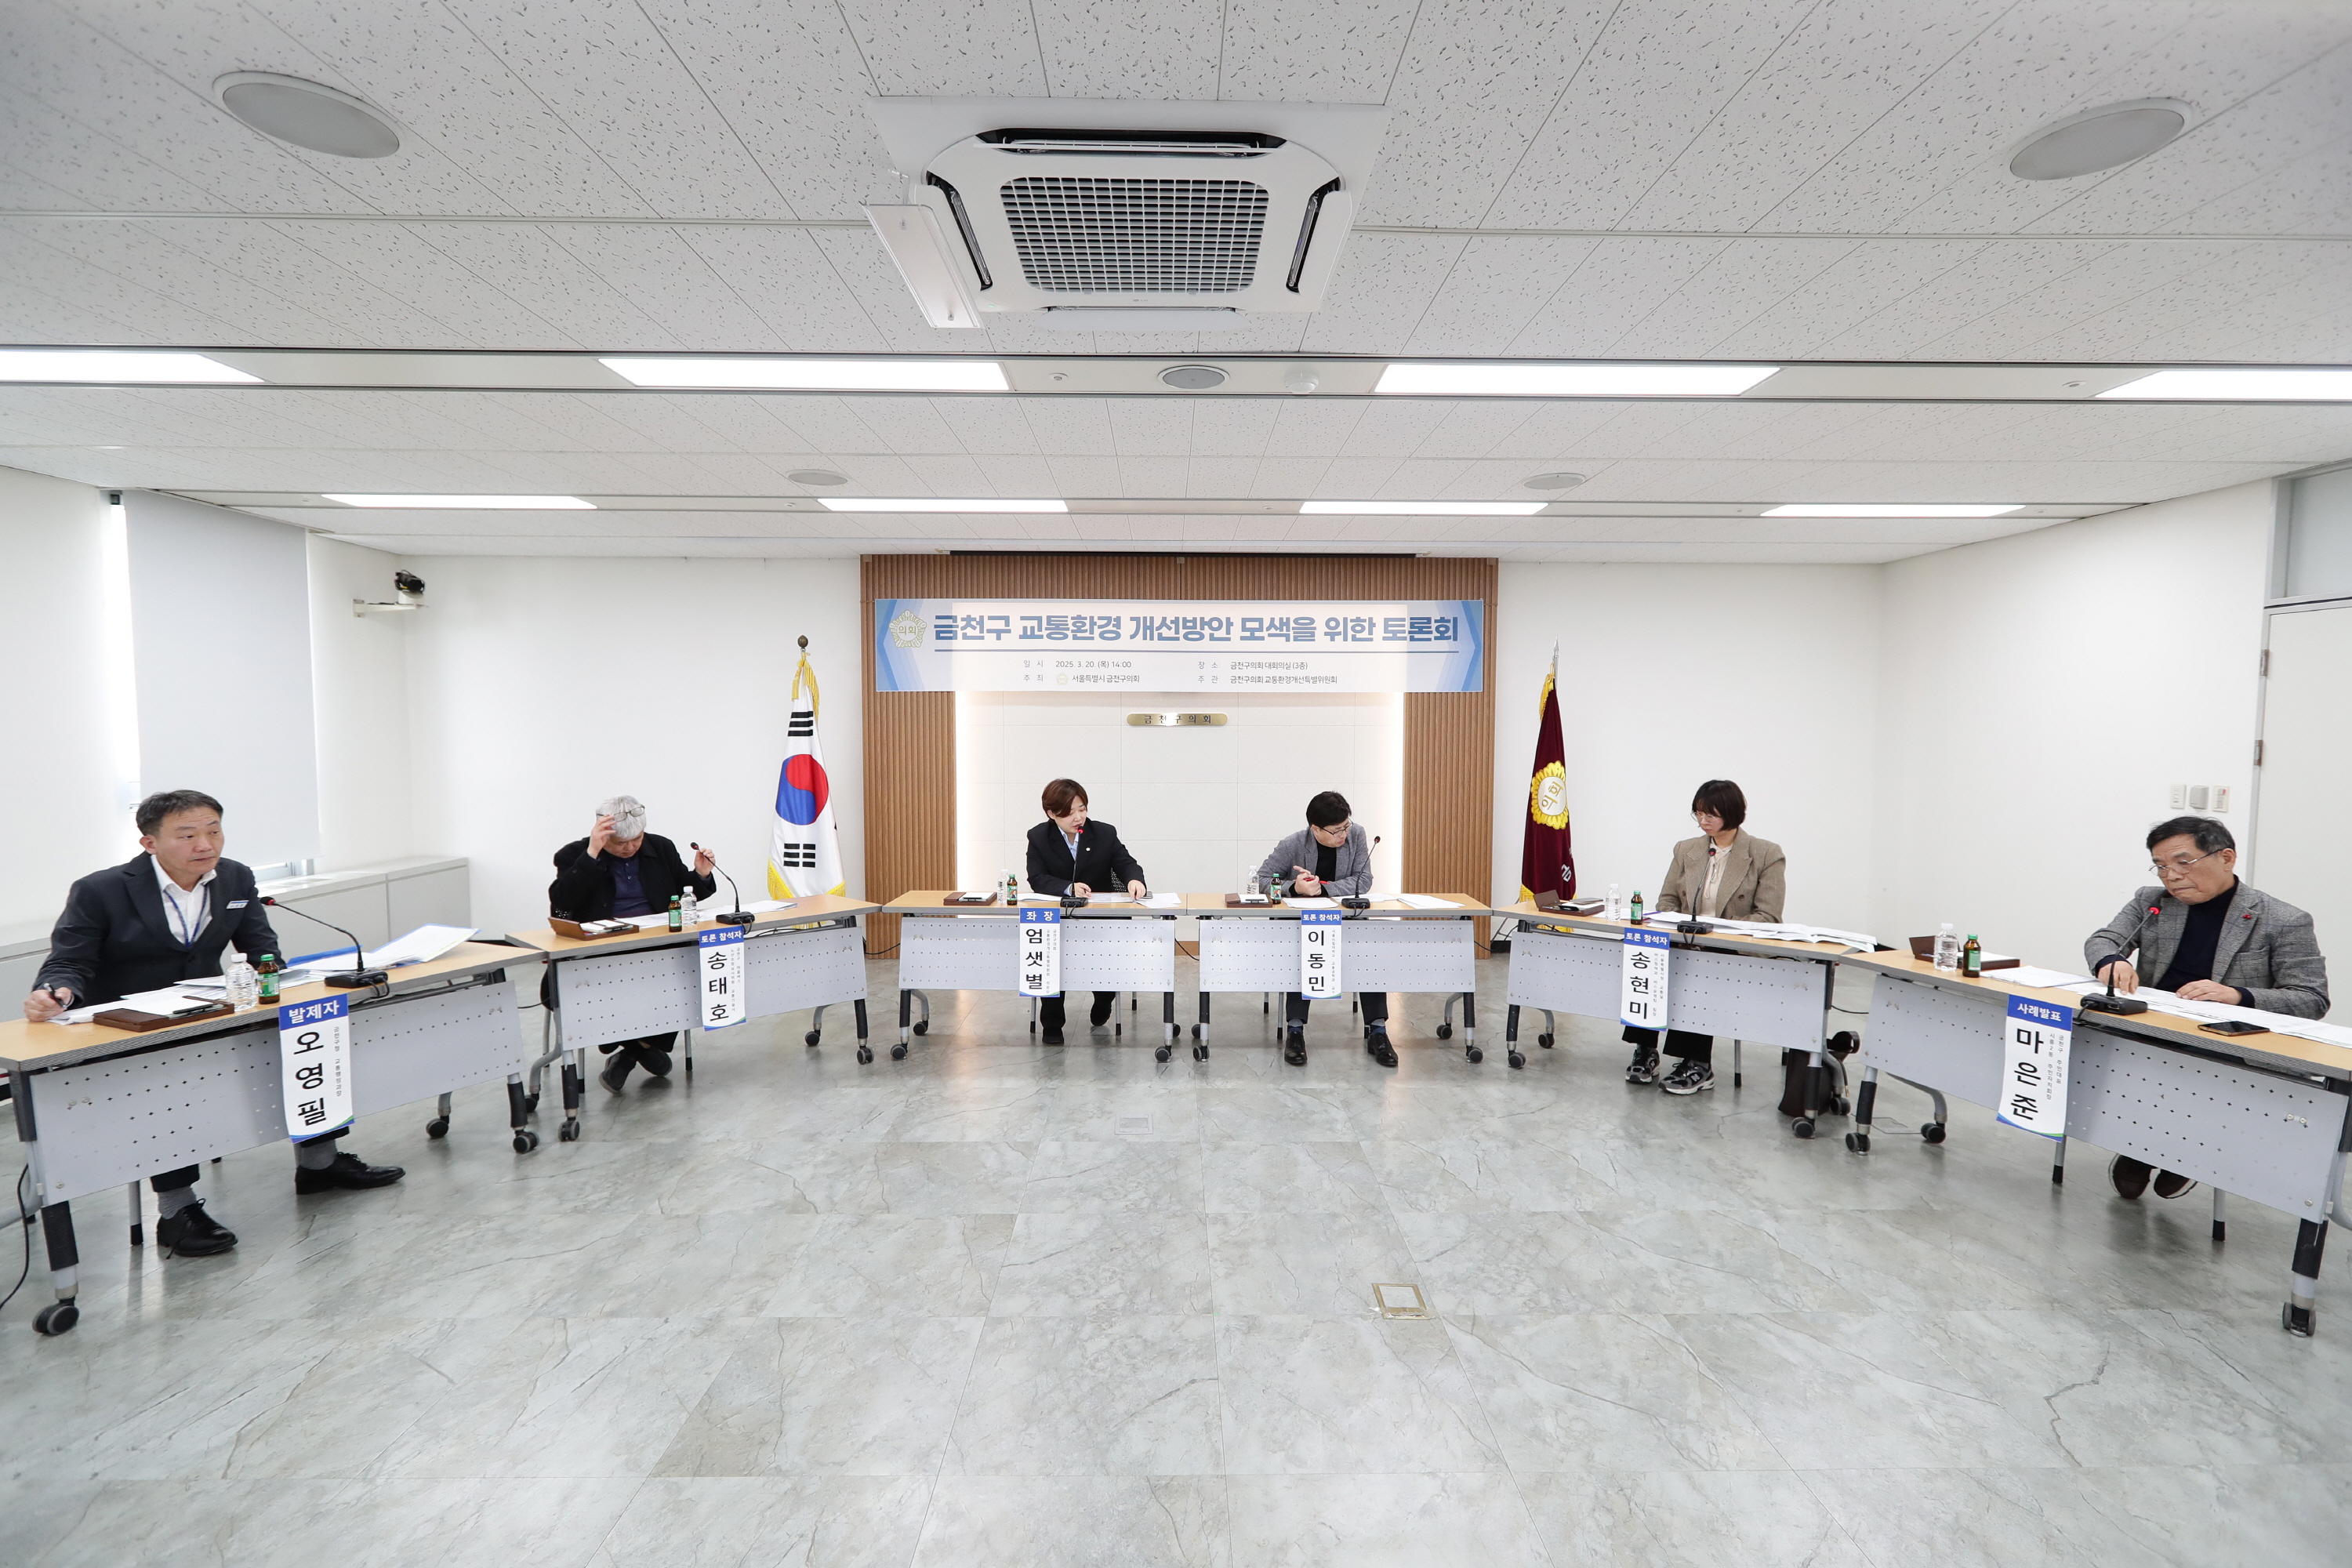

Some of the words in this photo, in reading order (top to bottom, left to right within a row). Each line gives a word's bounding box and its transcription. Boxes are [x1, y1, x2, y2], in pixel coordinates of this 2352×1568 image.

[898, 625, 916, 636] 의회
[934, 615, 1011, 641] 금천구
[1018, 615, 1122, 641] 교통환경
[1129, 615, 1234, 642] 개선방안
[1240, 616, 1317, 642] 모색을
[1324, 616, 1376, 642] 위한
[1381, 616, 1458, 642] 토론회
[1098, 660, 1109, 669] (목)
[1230, 661, 1264, 670] 금천구의회
[1264, 661, 1291, 670] 대회의실
[1292, 662, 1308, 670] (3층)
[1072, 674, 1105, 683] 서울특별시
[1106, 674, 1140, 684] 금천구의회
[1230, 675, 1264, 684] 금천구의회
[1265, 675, 1338, 684] 교통환경개선특별위원회
[1541, 781, 1564, 810] 의회
[1319, 913, 1340, 922] 참석자
[701, 933, 717, 943] 토론
[719, 930, 742, 942] 참석자
[1626, 932, 1642, 942] 토론
[1644, 935, 1668, 946] 참석자
[1025, 928, 1043, 990] 엄샛별
[1308, 930, 1326, 992] 이동민
[707, 951, 729, 1022] 송태호
[1629, 951, 1651, 1020] 송현미
[289, 1000, 340, 1024] 발제자
[2017, 1003, 2063, 1022] 사례발표
[293, 1031, 327, 1127] 오영필
[2011, 1028, 2044, 1121] 마은준
